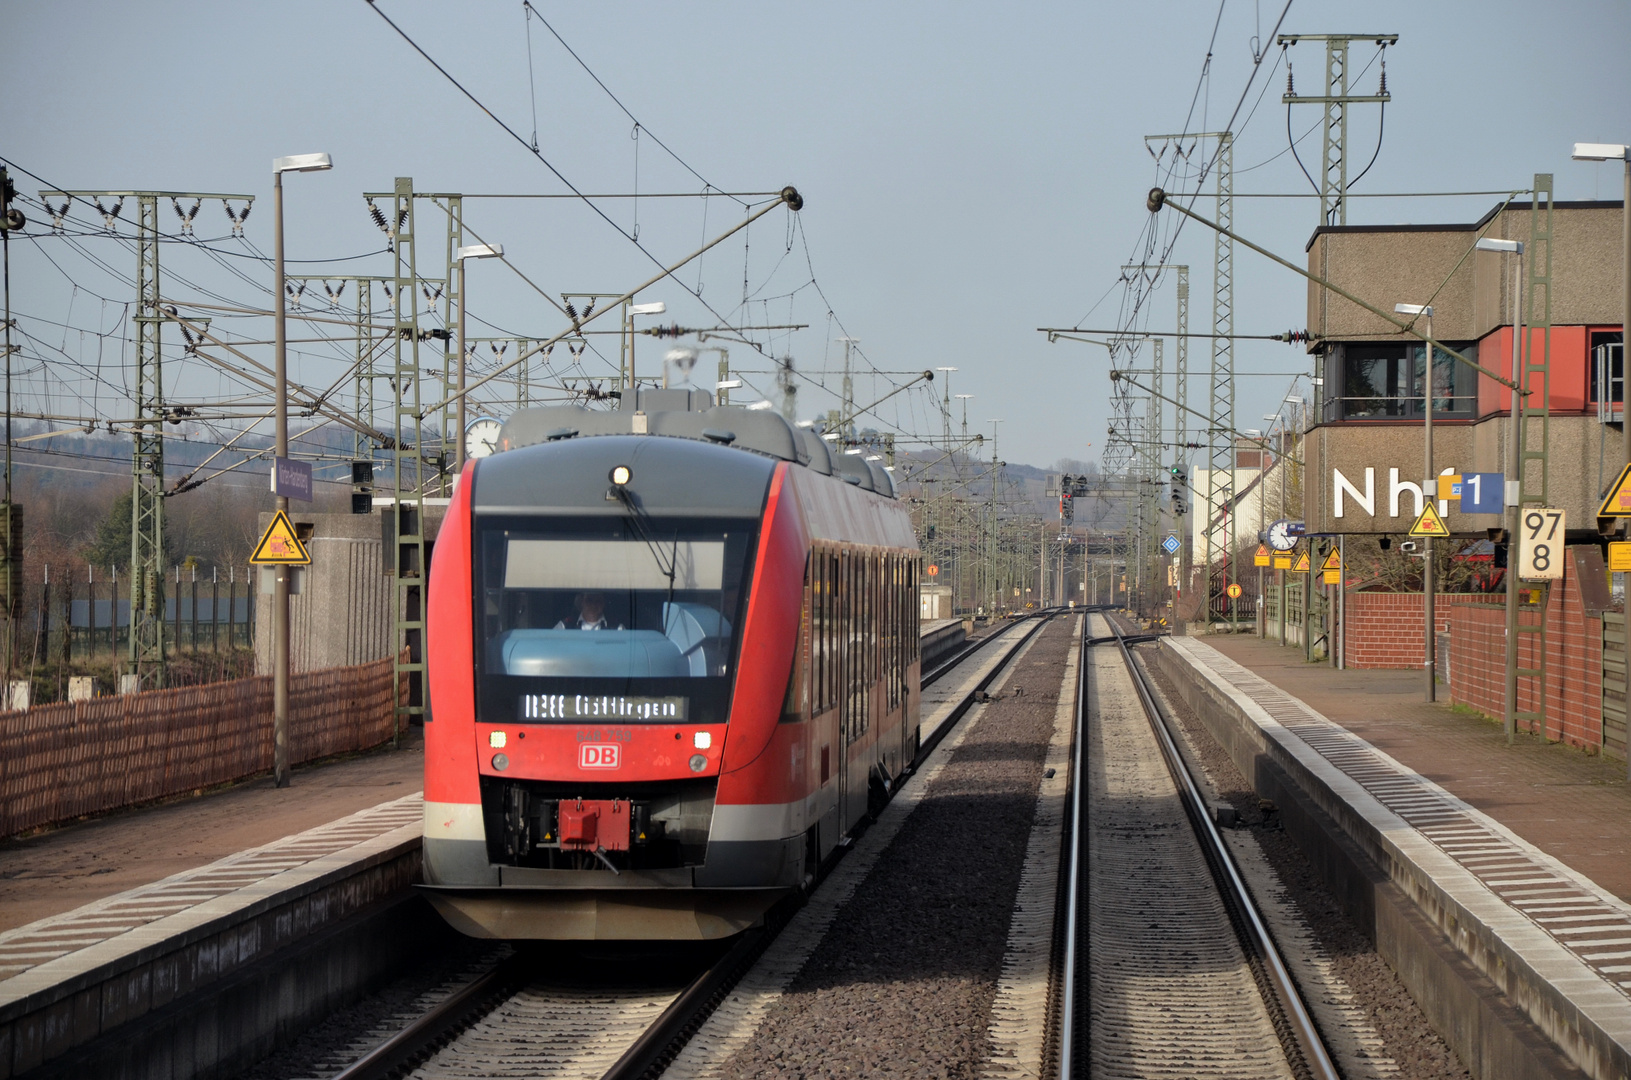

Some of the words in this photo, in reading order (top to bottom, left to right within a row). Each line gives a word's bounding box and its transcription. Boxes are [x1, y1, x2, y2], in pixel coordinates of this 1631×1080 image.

[1467, 474, 1481, 505] 1
[1525, 512, 1562, 540] 97
[1532, 543, 1550, 571] 8
[576, 730, 600, 742] 648
[607, 730, 632, 742] 759
[584, 747, 616, 764] DB
